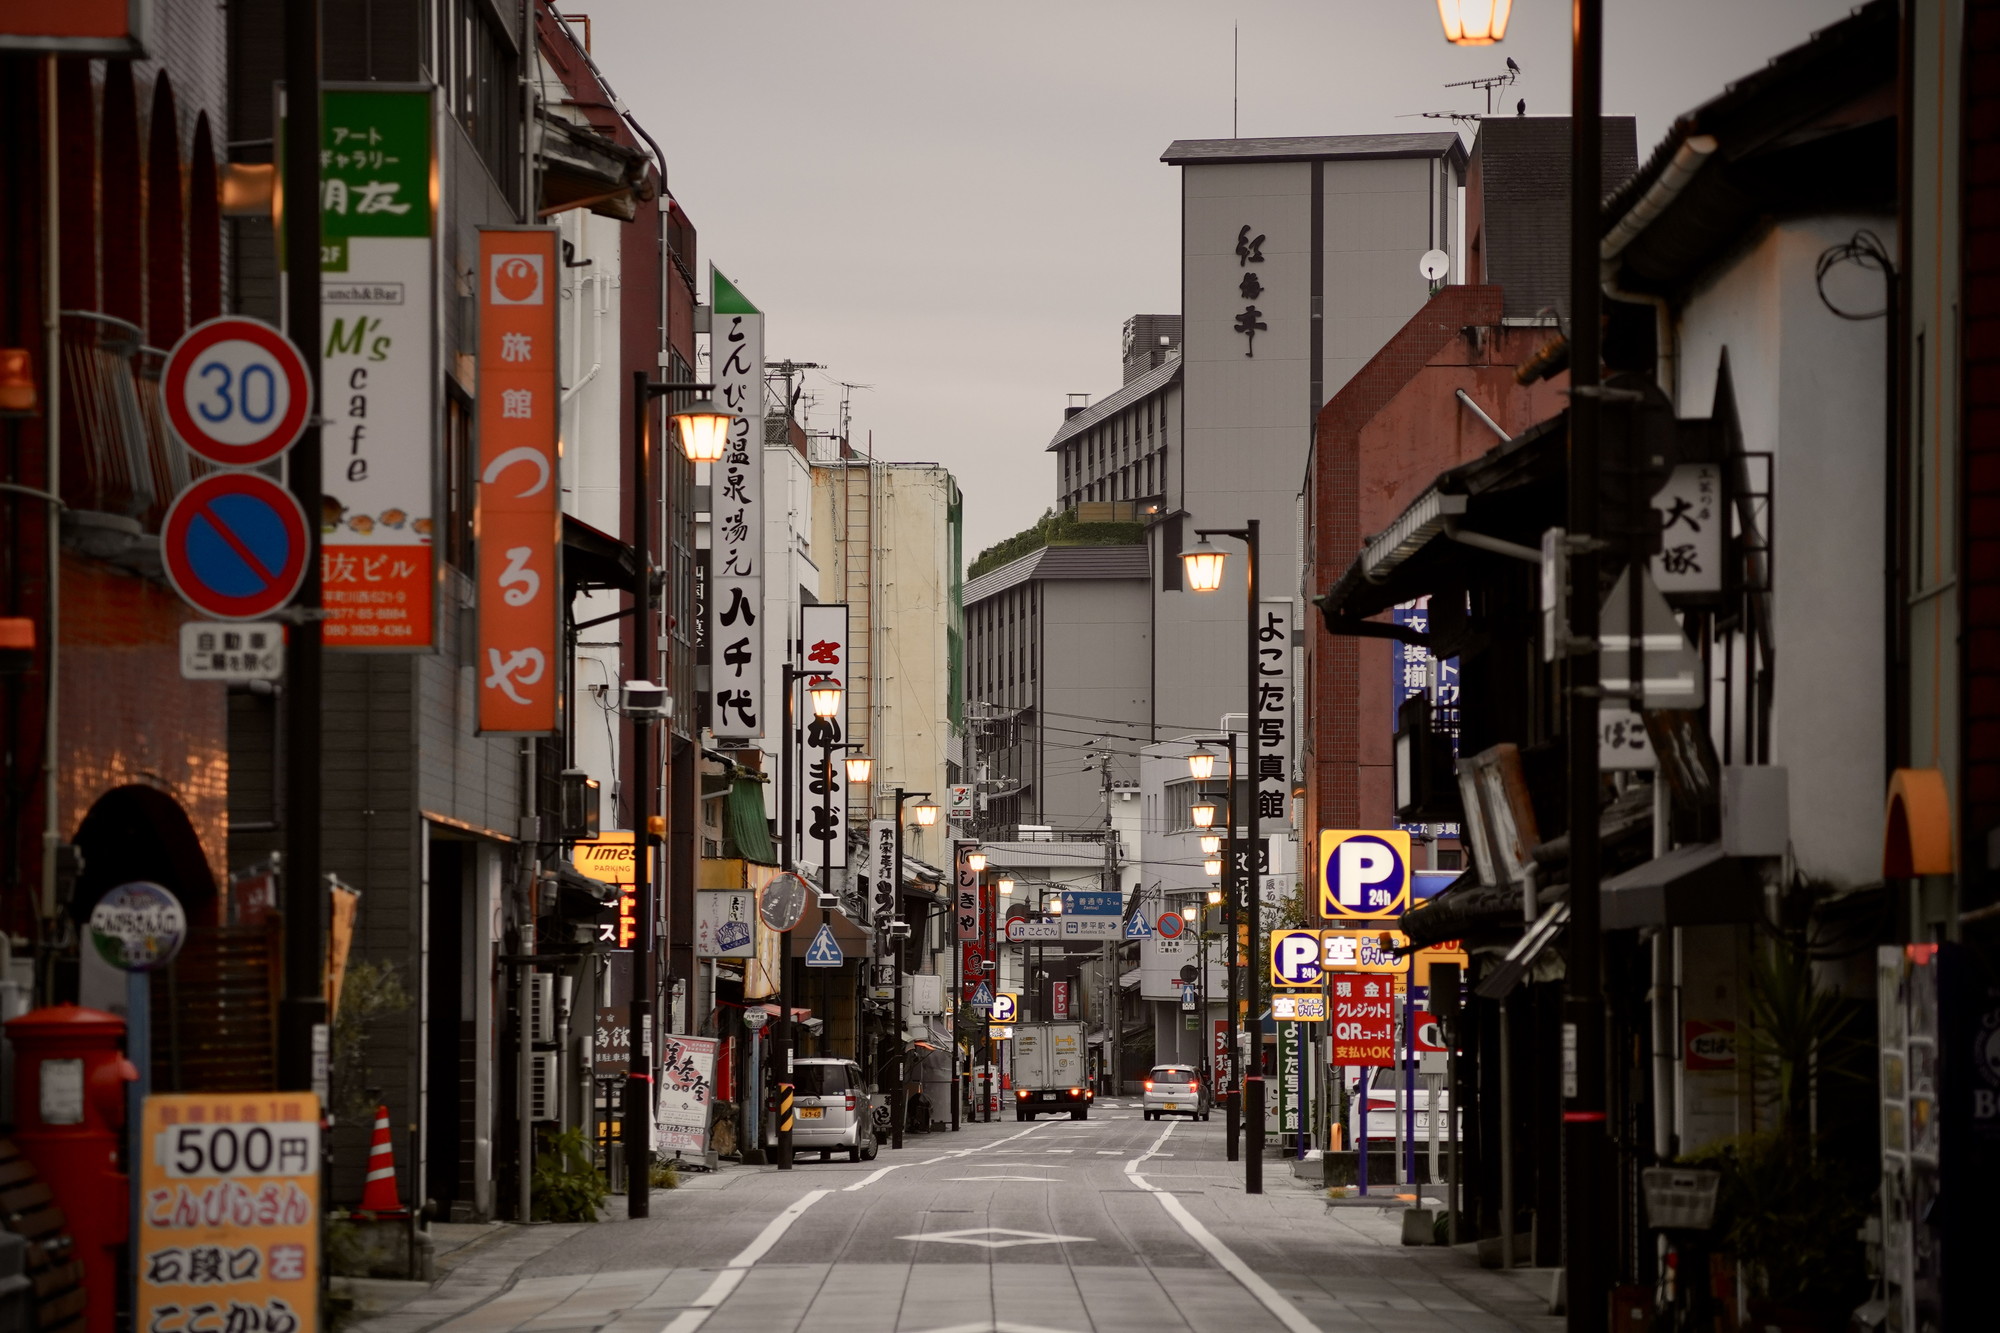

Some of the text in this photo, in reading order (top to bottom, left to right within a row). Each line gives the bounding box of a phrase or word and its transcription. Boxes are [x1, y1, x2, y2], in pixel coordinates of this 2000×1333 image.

[331, 126, 383, 146] アート
[320, 150, 399, 170] ギャラリー
[325, 316, 391, 361] M's
[198, 362, 276, 424] 30
[347, 368, 368, 482] cafe
[197, 633, 266, 649] 自動車
[1259, 612, 1284, 818] よこた写真館
[585, 844, 636, 860] Times
[1340, 842, 1394, 905] P
[1106, 897, 1112, 906] 5
[1369, 889, 1391, 905] 24h
[1012, 926, 1058, 937] JR ことでん
[1325, 936, 1357, 965] 空
[1302, 967, 1317, 978] 24h
[1057, 985, 1066, 1011] くすり
[1274, 998, 1296, 1018] 空
[1337, 1003, 1391, 1018] クレジット!
[1336, 1022, 1391, 1040] QRコード!
[1336, 1046, 1391, 1059] 支払いOK
[177, 1128, 307, 1173] 500円
[151, 1184, 307, 1227] こんぴらさん
[150, 1248, 304, 1283] 石段口 左
[152, 1302, 295, 1333] ここから
